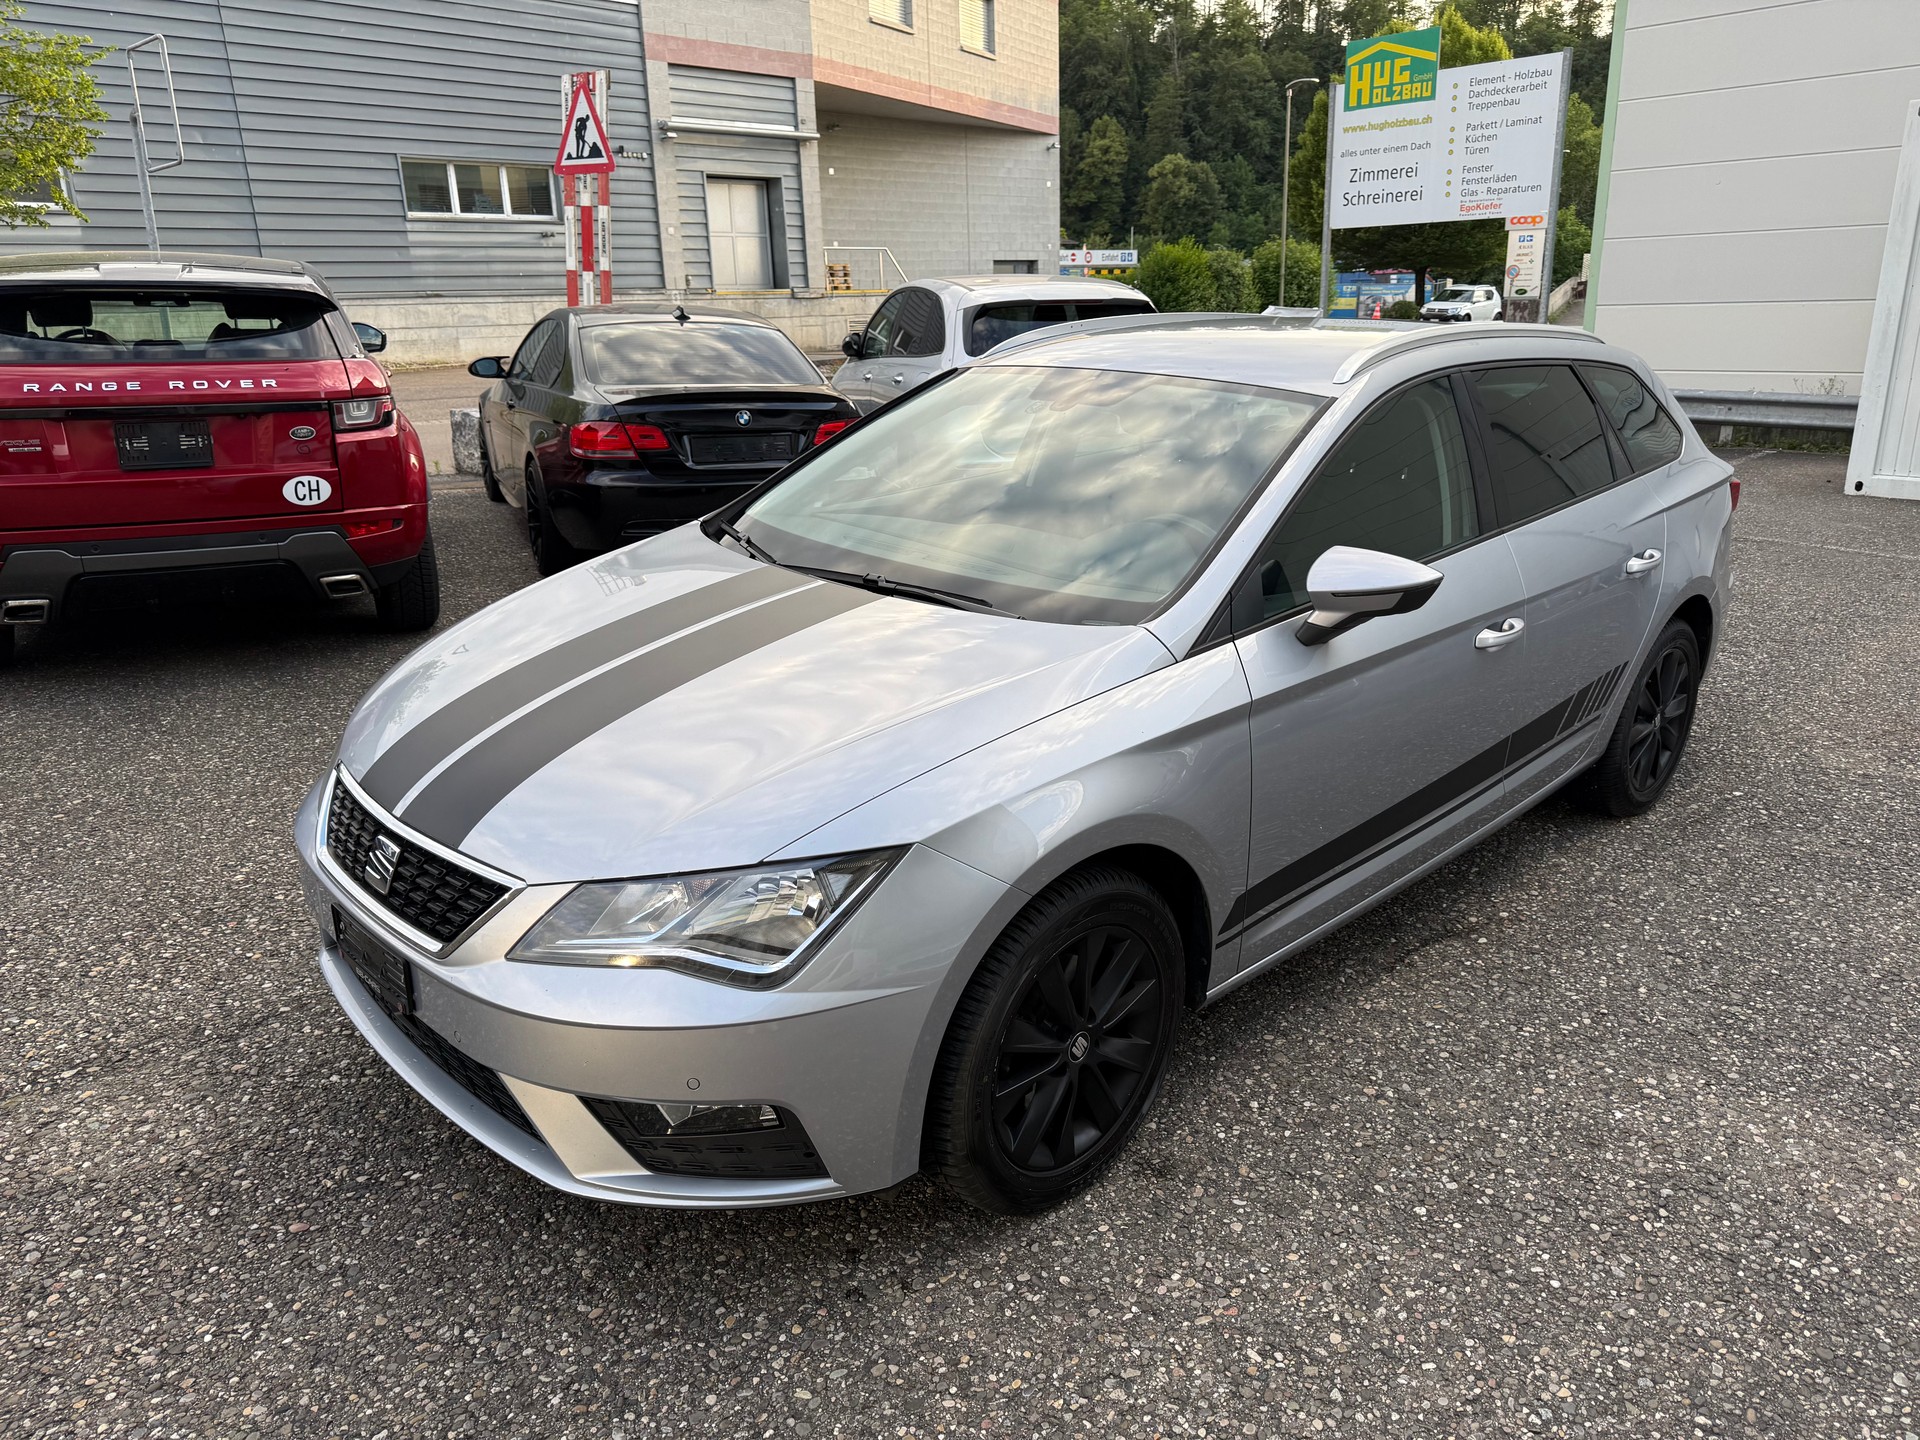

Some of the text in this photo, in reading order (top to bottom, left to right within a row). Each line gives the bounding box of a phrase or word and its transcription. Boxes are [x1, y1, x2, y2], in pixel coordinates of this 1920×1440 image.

[1349, 57, 1411, 107] HUG
[1413, 72, 1433, 81] GmbH
[1469, 74, 1506, 87] Element
[1514, 68, 1553, 81] Holzbau
[1468, 80, 1548, 99] Dachdeckerarbeit
[1467, 97, 1521, 111] Treppenbau
[1342, 114, 1433, 134] www.hugholzbau.ch
[1465, 121, 1498, 132] Parkett
[1505, 115, 1543, 128] Laminat
[1465, 133, 1498, 144] Küchen
[1340, 140, 1432, 158] alles unter einem Dach
[1464, 146, 1490, 155] Türen
[1349, 161, 1419, 183] Zimmerei
[1462, 164, 1494, 174] Fenster
[1461, 173, 1518, 186] Fensterläden
[1342, 185, 1423, 207] Schreinerei
[1460, 188, 1479, 198] Glas
[1486, 183, 1542, 196] Reparaturen
[1459, 202, 1503, 213] EgoKiefer
[1510, 215, 1544, 227] coop
[23, 379, 278, 392] RANGE ROVER
[294, 479, 321, 502] CH
